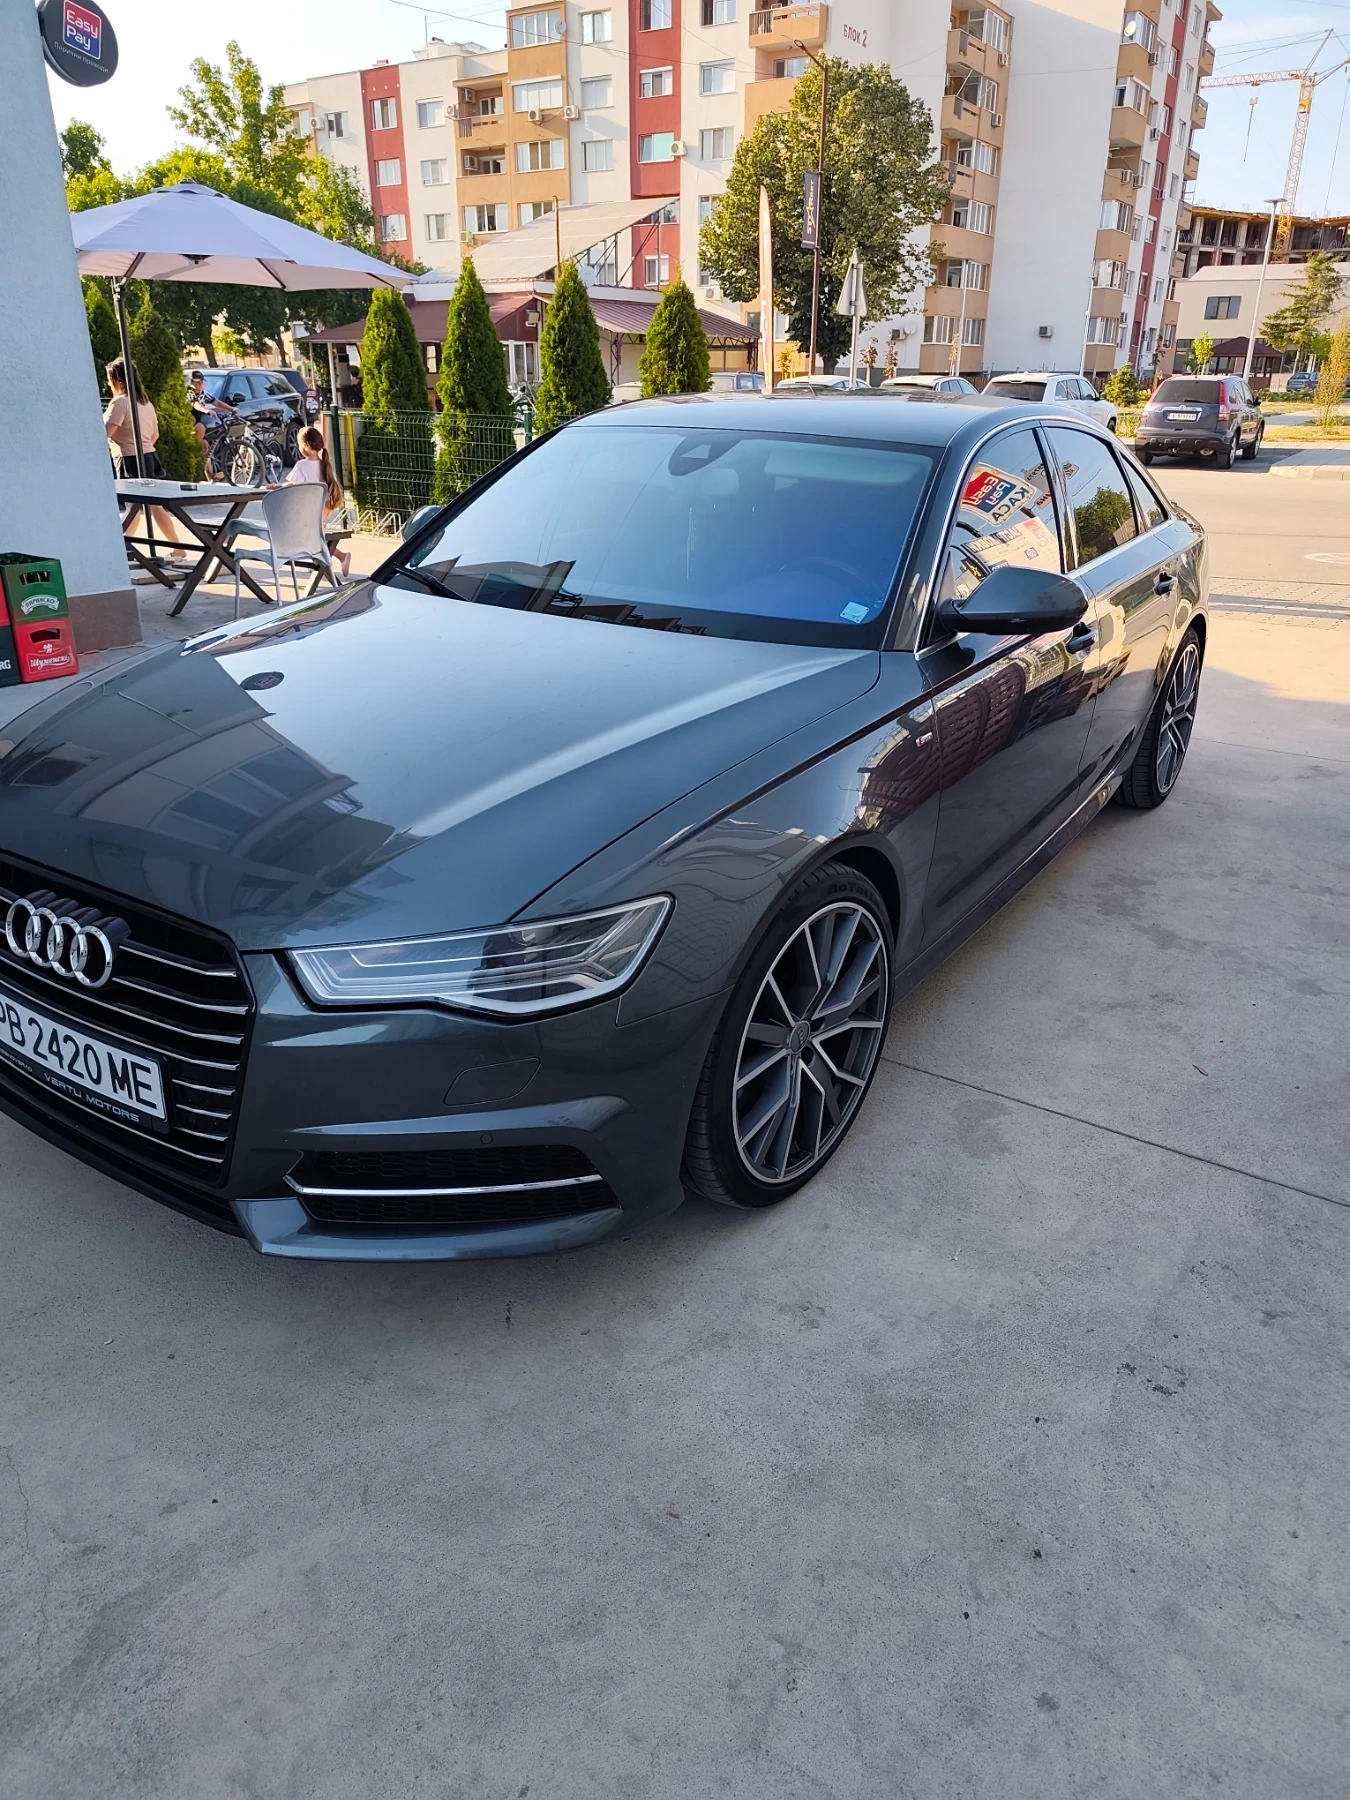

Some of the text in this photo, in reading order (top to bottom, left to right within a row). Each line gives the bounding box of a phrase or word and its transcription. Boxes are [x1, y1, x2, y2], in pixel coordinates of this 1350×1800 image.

[66, 9, 98, 39] Easy
[66, 25, 91, 51] Pay
[843, 23, 868, 48] БЛОК 2
[28, 1017, 102, 1085] 2420
[107, 1051, 157, 1110] ME
[44, 1073, 82, 1098] VERTU
[86, 1094, 140, 1122] MOTORS
